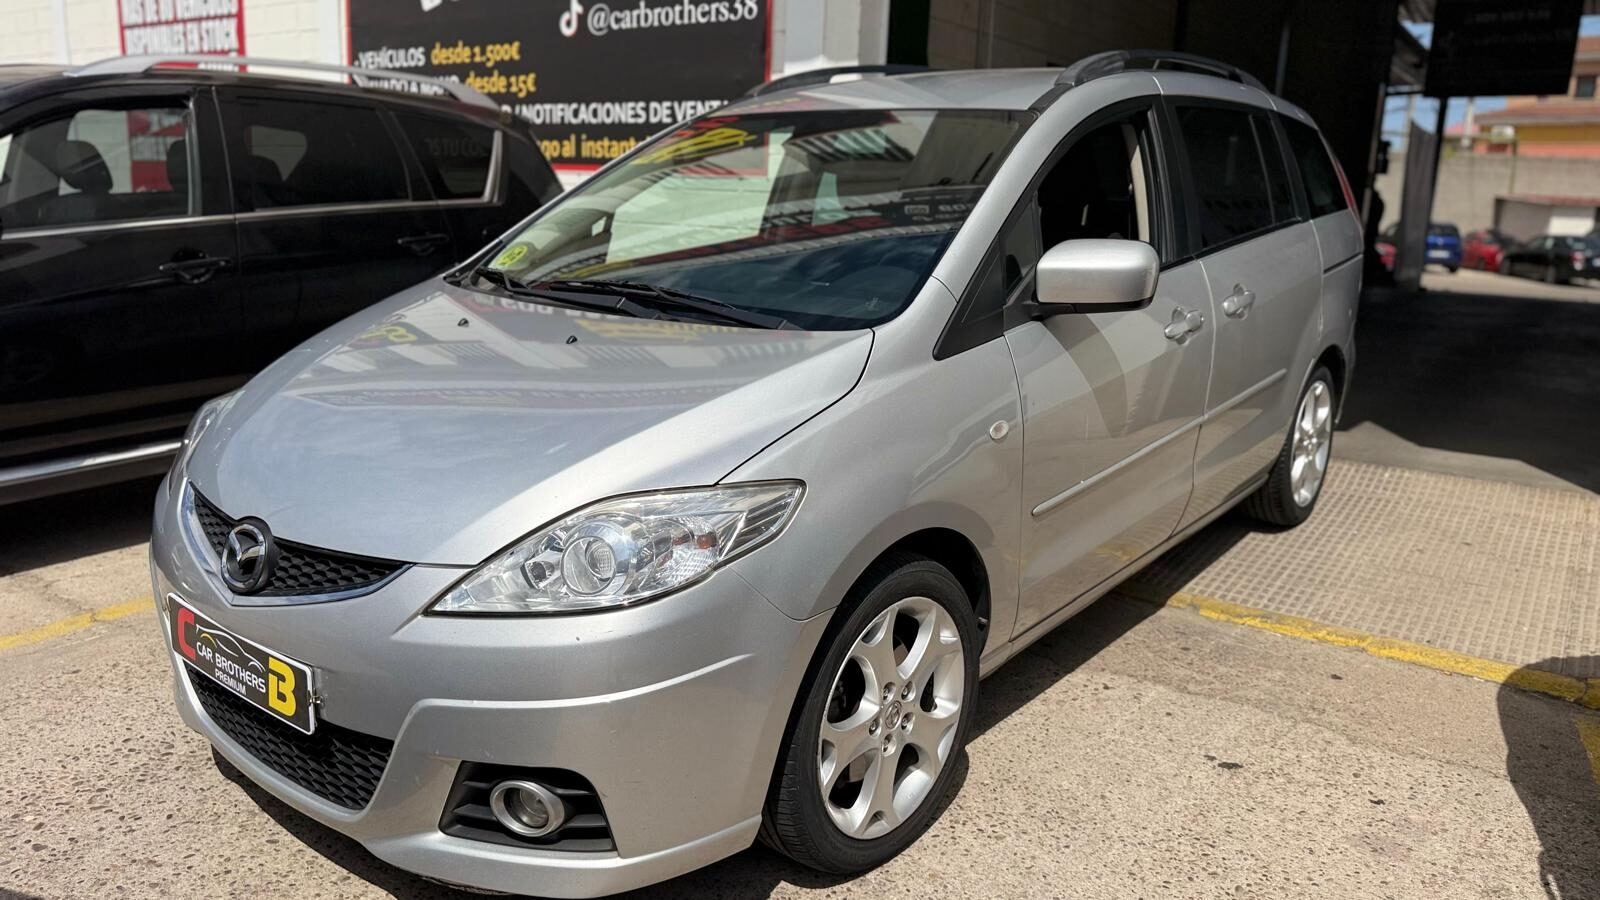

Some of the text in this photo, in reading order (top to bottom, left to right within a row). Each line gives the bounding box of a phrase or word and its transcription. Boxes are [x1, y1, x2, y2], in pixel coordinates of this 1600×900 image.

[587, 0, 758, 36] @carbrothers38
[431, 40, 471, 66] desde
[473, 41, 521, 67] 1.500€
[465, 69, 508, 94] desde
[509, 73, 537, 98] 15€
[649, 101, 673, 124] DE
[561, 133, 577, 158] al
[196, 642, 266, 694] CAR BROTHERS
[214, 668, 247, 696] PREMIUM
